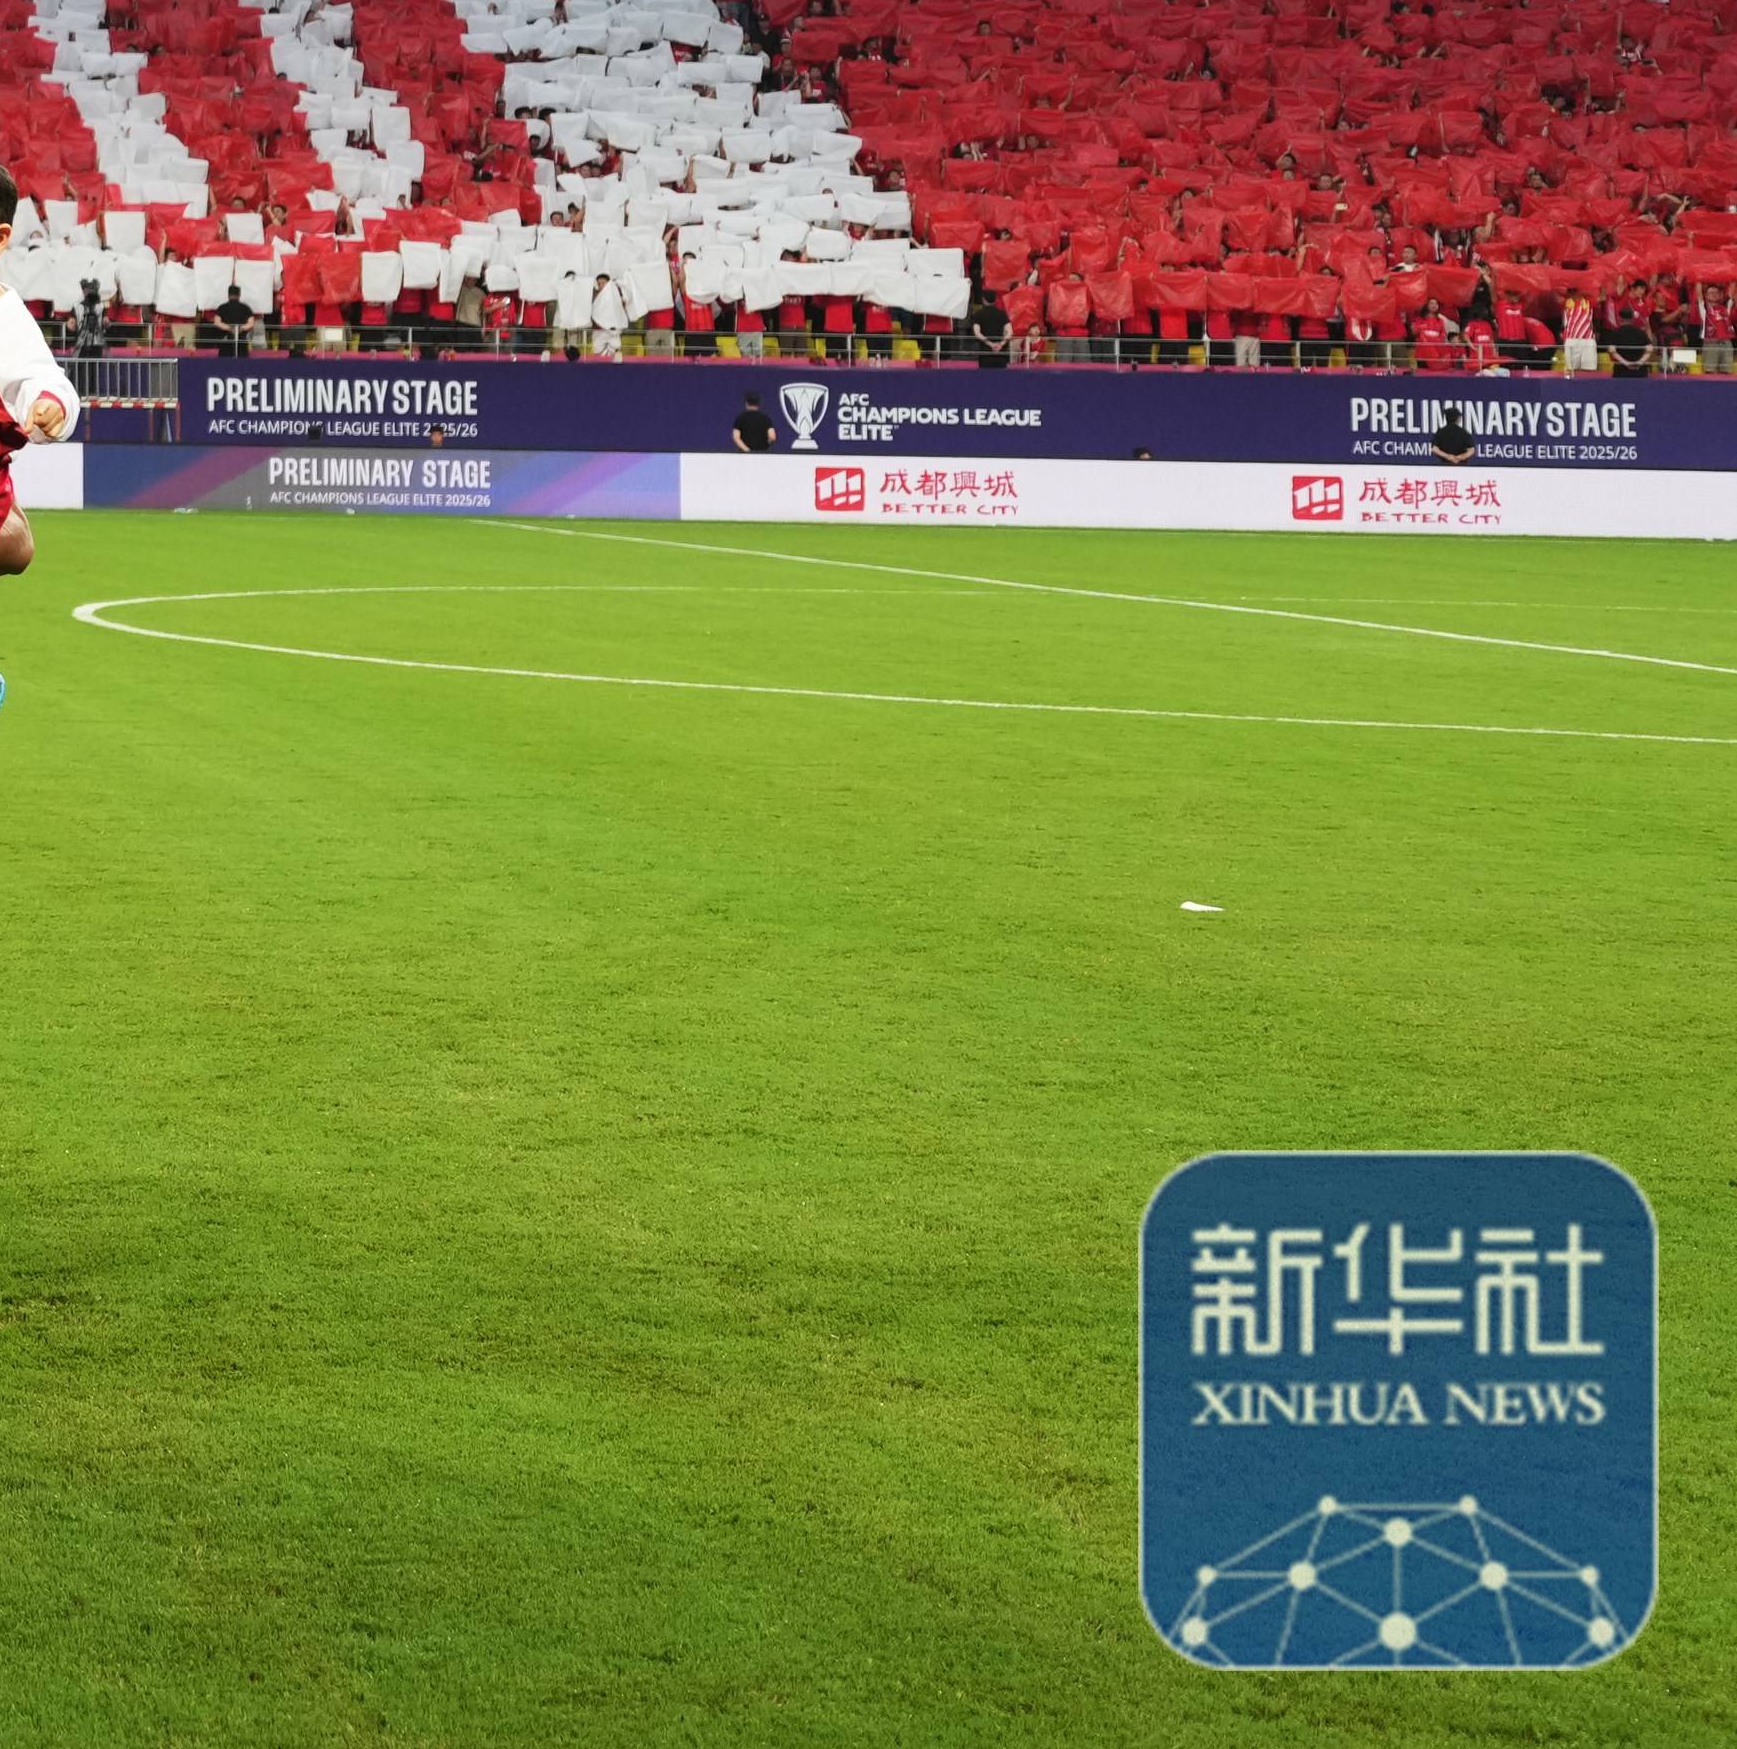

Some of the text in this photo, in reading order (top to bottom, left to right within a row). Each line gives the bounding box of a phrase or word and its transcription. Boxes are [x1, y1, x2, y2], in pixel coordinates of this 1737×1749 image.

[207, 377, 479, 416] PRELIMINARY STAGE
[839, 393, 869, 406] AFC
[837, 407, 1043, 426] CHAMPIONS LEAGUE
[1546, 401, 1638, 439] STAGE
[209, 419, 235, 435] AFC
[327, 421, 381, 436] LEAGUE
[383, 422, 420, 437] ELITE
[422, 422, 479, 438] 225/26
[838, 424, 894, 441] ELITE
[1353, 440, 1381, 455] AFC
[1477, 443, 1534, 459] LEAGUE
[1537, 444, 1576, 460] ELITE
[1579, 445, 1639, 461] 2025/26
[269, 457, 492, 489] PRELIMINARY STAGE
[879, 469, 1019, 501] 成都興城
[1359, 478, 1502, 509] 成都興城
[270, 491, 491, 508] AFC CHAMPIONS LEAGUE ELITE 2025/26
[882, 503, 1020, 516] BETTER CITY
[1361, 512, 1502, 525] BETTER CITY
